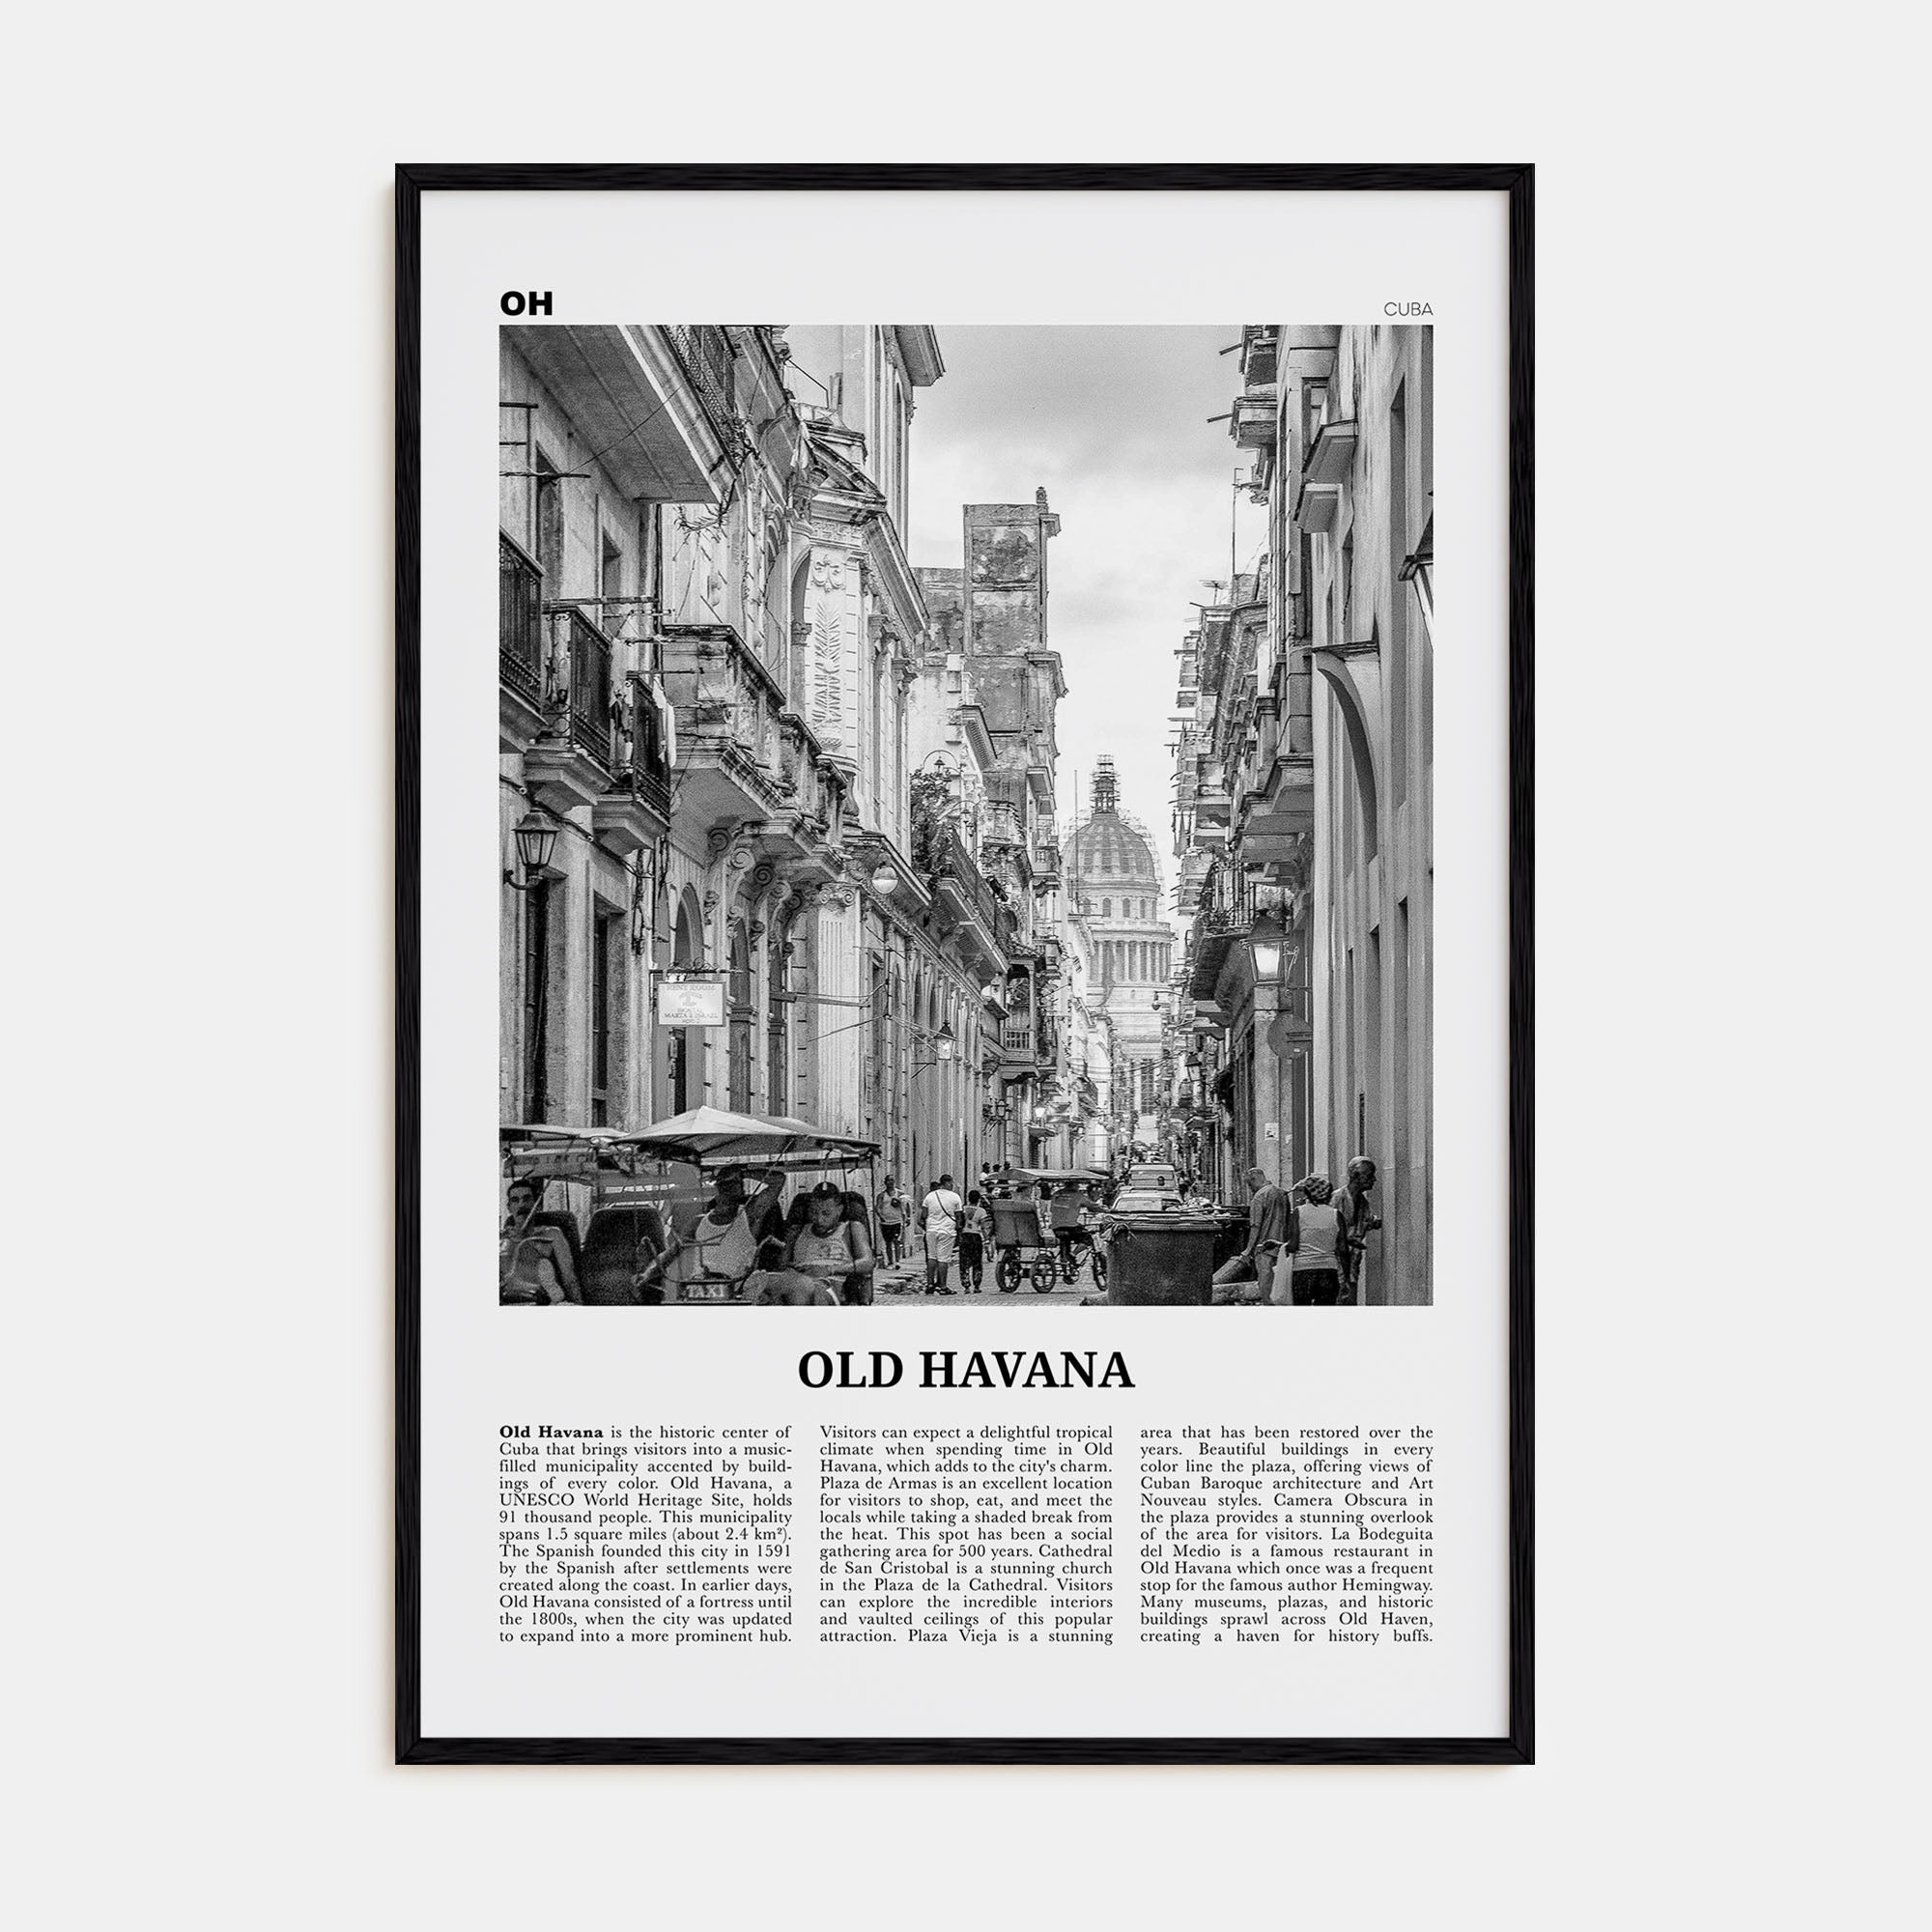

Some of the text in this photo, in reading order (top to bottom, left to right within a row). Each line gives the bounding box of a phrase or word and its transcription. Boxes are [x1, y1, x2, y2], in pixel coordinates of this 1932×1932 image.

[499, 290, 554, 317] OH
[1383, 301, 1434, 317] CUBA
[685, 1284, 724, 1298] TAXI
[798, 1350, 1137, 1389] OLD HAVANA
[498, 1425, 793, 1438] Old Havana is the historic center of
[819, 1425, 1113, 1442] Visitors can expect a delightful tropical
[1140, 1425, 1434, 1438] area that has been restored over the
[498, 1442, 793, 1460] Cuba that brings visitors into a music-
[819, 1442, 1114, 1460] climate when spending time in Old
[1139, 1442, 1435, 1460] years. Beautiful buildings in every
[498, 1459, 793, 1476] filled municipality accented by build-
[820, 1459, 1113, 1476] Havana, which adds to the city's charm.
[1140, 1459, 1434, 1476] color line the plaza, offering views of
[498, 1492, 793, 1510] UNESCO World Heritage Site, holds
[819, 1492, 1113, 1510] for visitors to shop, eat, and meet the
[1140, 1492, 1434, 1510] Nouveau styles. Camera Obscura in
[498, 1510, 793, 1527] 91 thousand people. This municipality
[498, 1544, 790, 1561] The Spanish founded this city in 1591
[819, 1544, 1113, 1561] gathering area for 500 years. Cathedral
[1140, 1544, 1434, 1557] del Medio is a famous restaurant in
[498, 1595, 792, 1608] Old Havana consisted of a fortress until
[819, 1595, 1114, 1612] can explore the incredible interiors
[1140, 1595, 1434, 1612] Many museums, plazas, and historic
[498, 1629, 792, 1646] to expand into a more prominent hub.
[819, 1629, 1114, 1646] attraction. Plaza Vieja is a stunning
[1140, 1629, 1434, 1646] creating a haven for history buffs.
